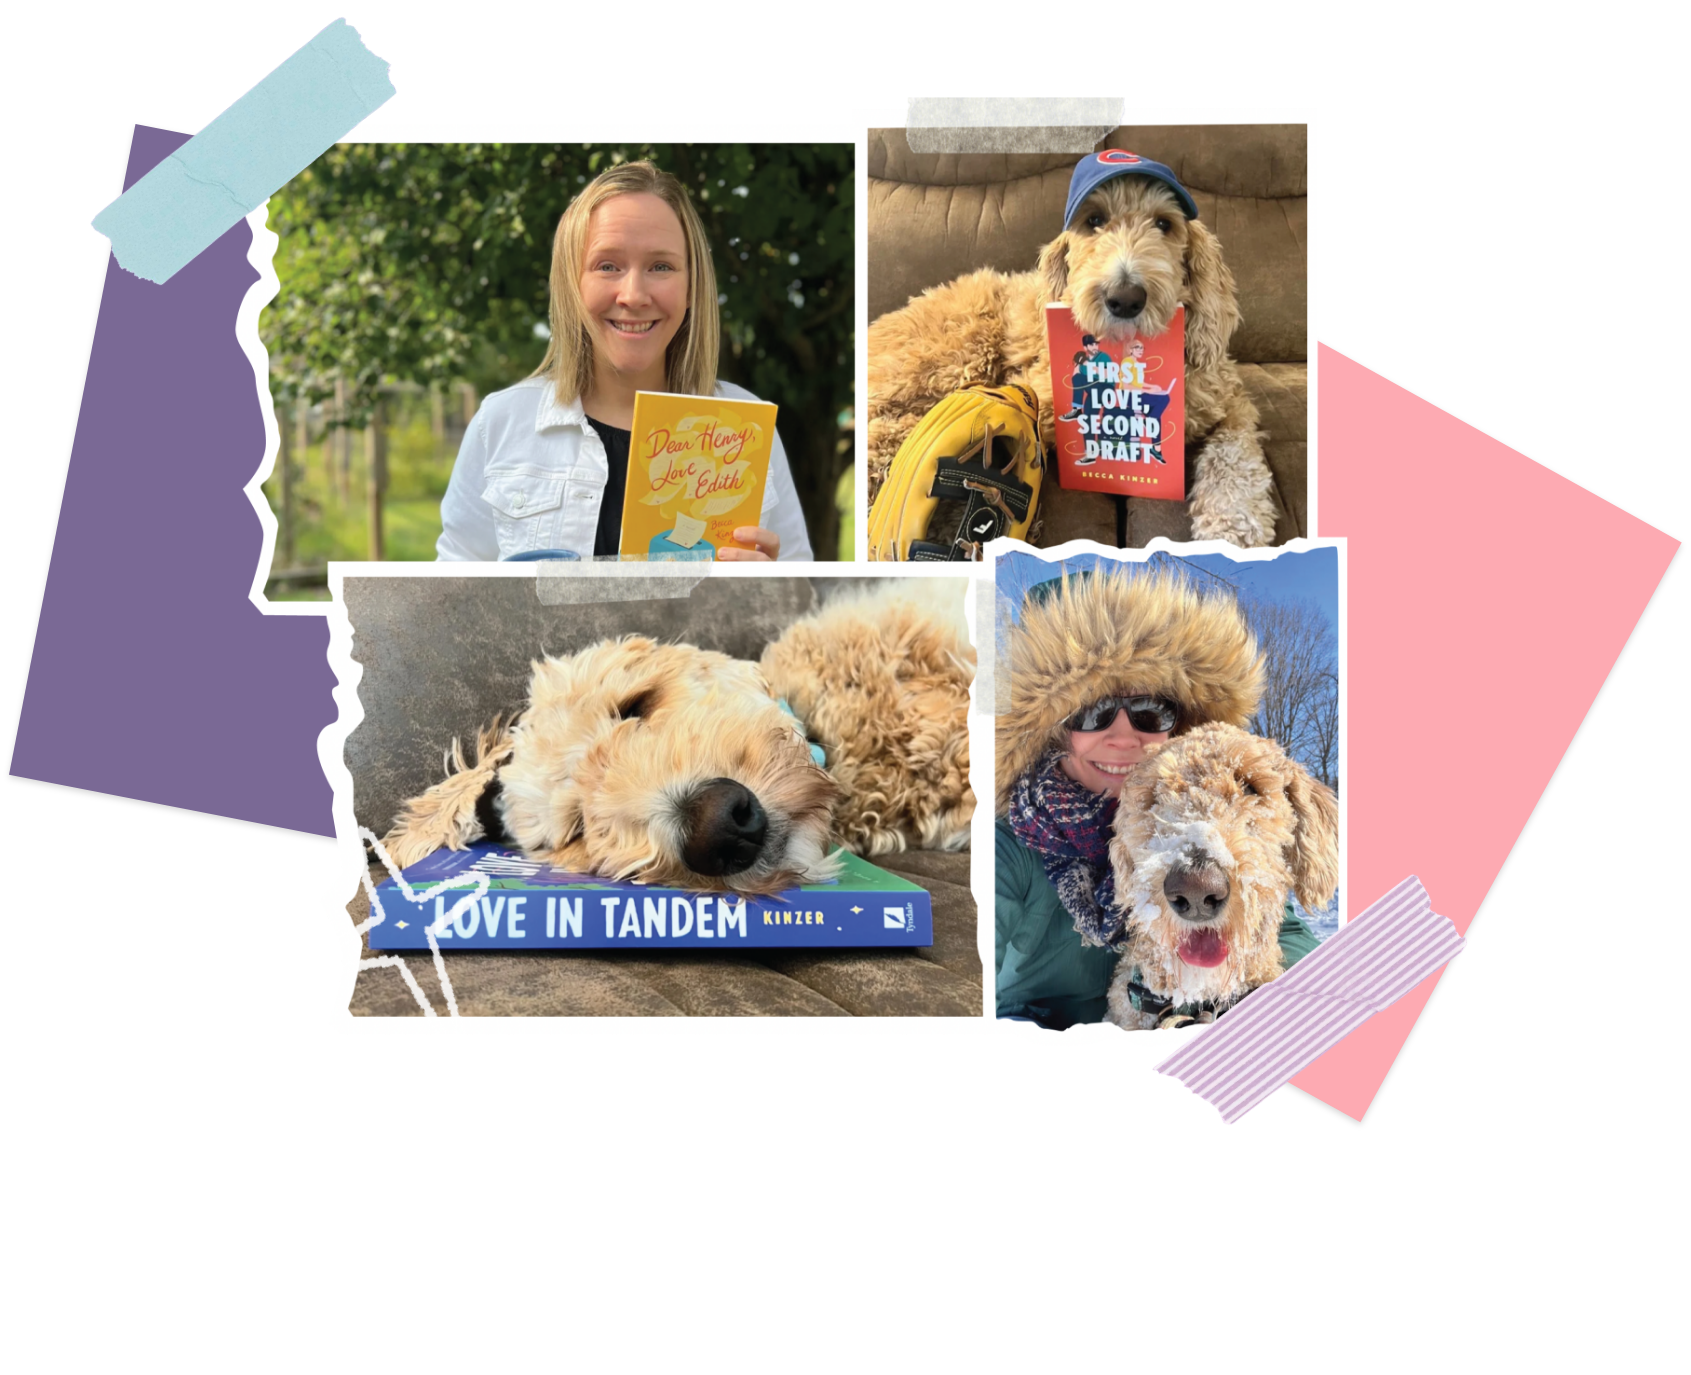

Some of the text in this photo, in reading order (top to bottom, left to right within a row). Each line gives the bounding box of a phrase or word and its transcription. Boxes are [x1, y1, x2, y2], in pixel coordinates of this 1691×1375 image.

[1096, 148, 1142, 165] C
[1086, 361, 1147, 383] FIRST
[1091, 388, 1150, 415] LOVE,
[1077, 415, 1160, 439] SECOND
[645, 421, 756, 465] Dear Henry,
[1085, 439, 1153, 464] DRAFT
[651, 459, 697, 492] Love
[695, 469, 745, 499] Edith
[1082, 471, 1158, 484] BECCA KINZER
[434, 896, 824, 939] LOVE IN TANDEM KINZER
[905, 902, 916, 933] Tyndale
